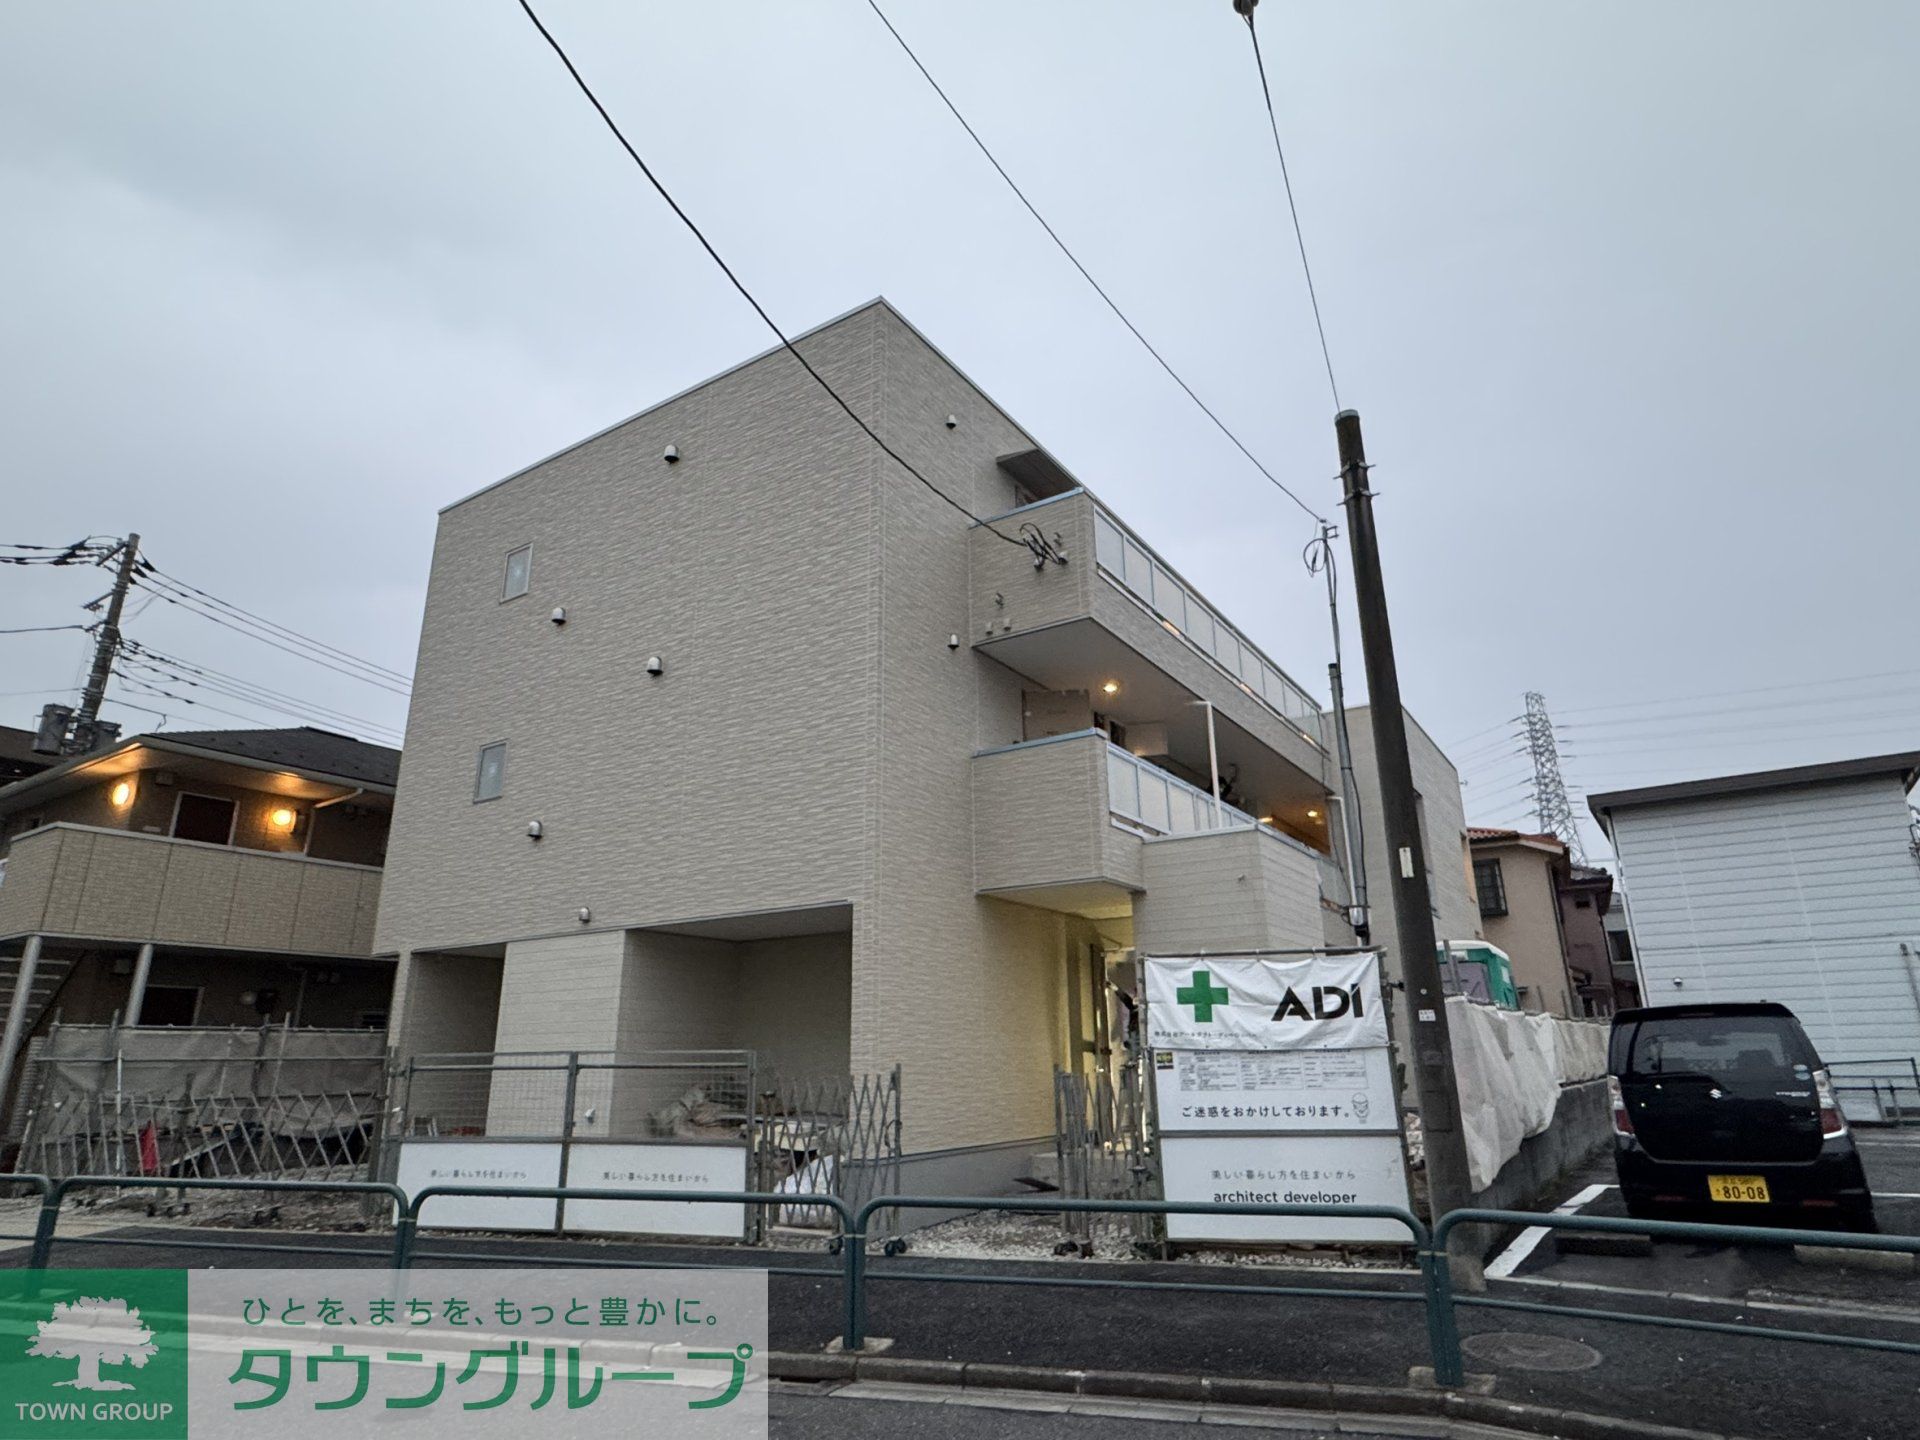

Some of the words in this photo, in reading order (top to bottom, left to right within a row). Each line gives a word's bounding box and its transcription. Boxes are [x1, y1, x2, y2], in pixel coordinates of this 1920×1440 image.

[1271, 983, 1364, 1021] ADI
[1181, 1105, 1350, 1119] ご迷惑をおかけしております。
[1211, 1169, 1356, 1181] 美しい暮らし方を住まいから
[1213, 1190, 1278, 1203] architect
[1283, 1190, 1357, 1205] developer
[1722, 1186, 1766, 1200] 80-08
